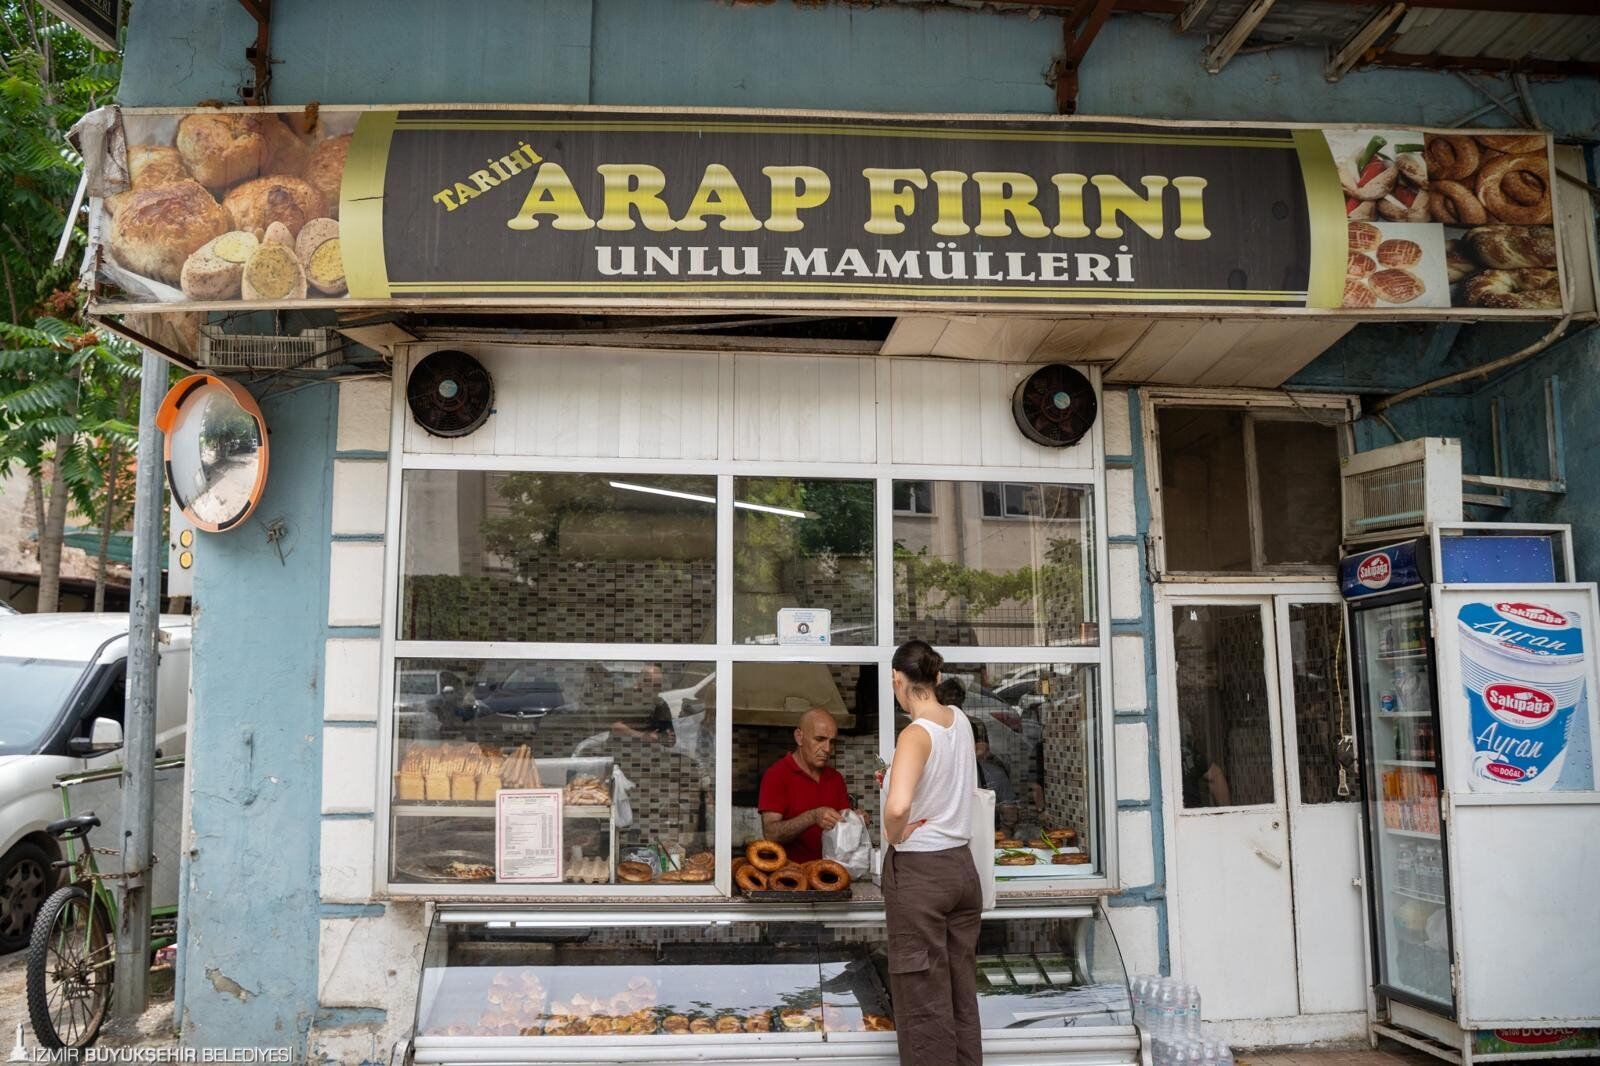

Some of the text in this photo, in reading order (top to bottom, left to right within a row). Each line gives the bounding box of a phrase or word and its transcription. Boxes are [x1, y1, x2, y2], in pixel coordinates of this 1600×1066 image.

[433, 141, 543, 212] TARİHİ
[507, 162, 1211, 240] ARAP FIRINI
[595, 242, 1134, 282] UNLU MAMÜLLERİ
[1473, 620, 1568, 651] Ayran
[1476, 722, 1544, 760] Ayran
